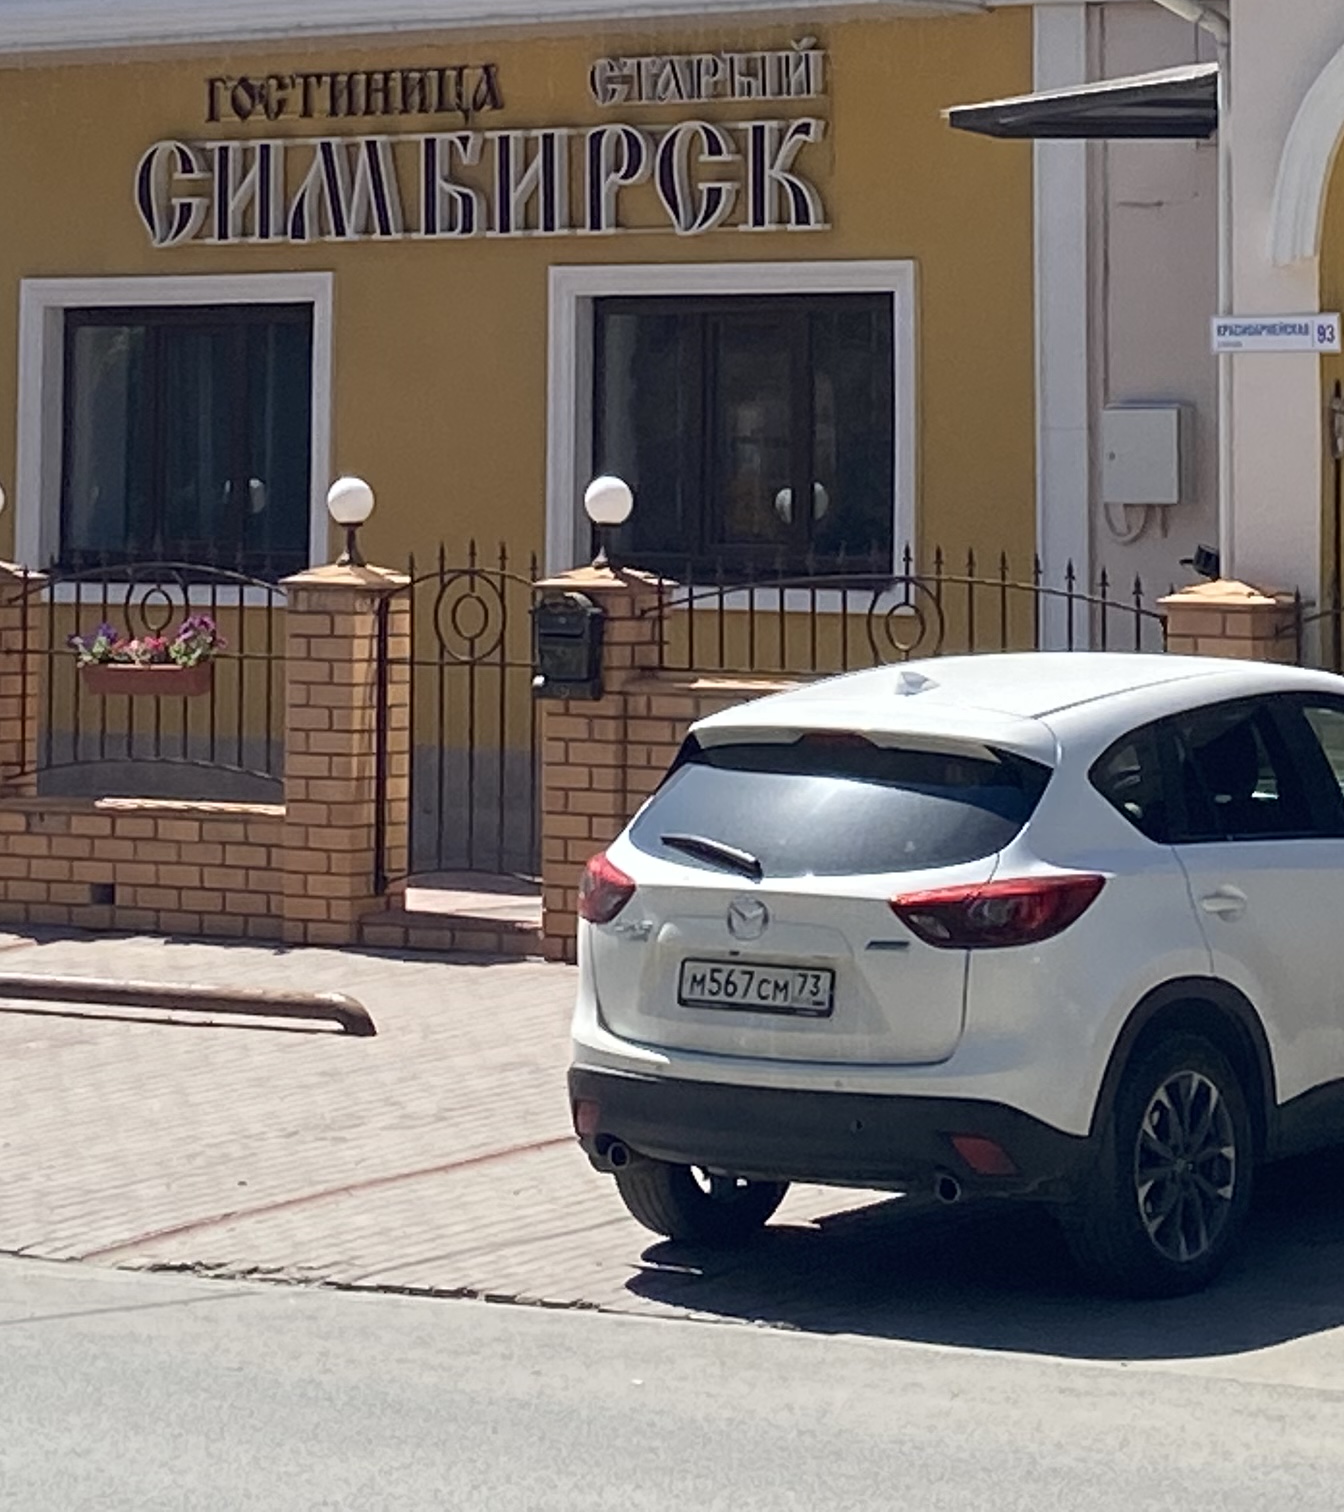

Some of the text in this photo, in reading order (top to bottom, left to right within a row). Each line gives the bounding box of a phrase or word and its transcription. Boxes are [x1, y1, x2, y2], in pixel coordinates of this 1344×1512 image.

[204, 37, 826, 124] ГОСТИНИЦА СТАРЫЙ
[134, 119, 831, 247] СИМБИРСК
[1317, 324, 1335, 343] 93
[796, 972, 821, 997] 73
